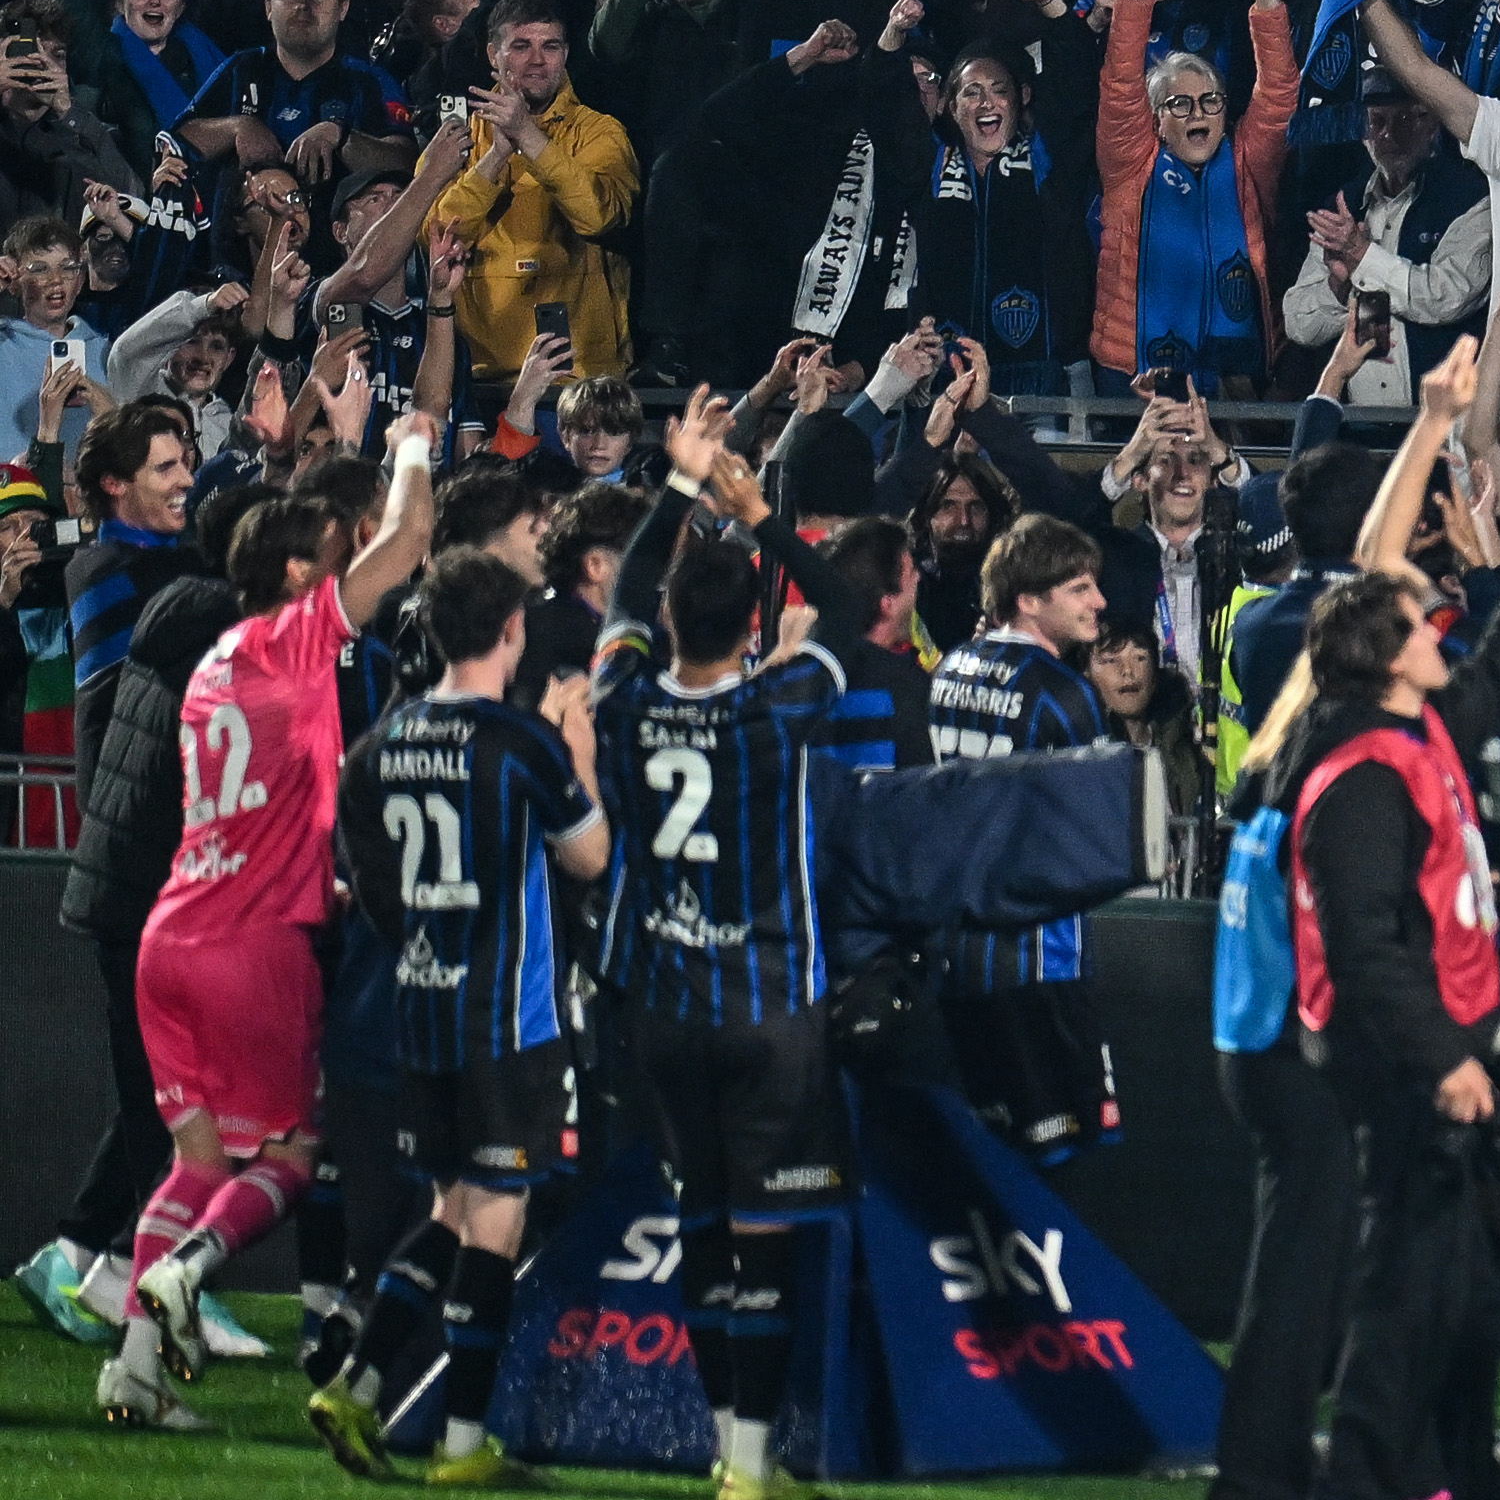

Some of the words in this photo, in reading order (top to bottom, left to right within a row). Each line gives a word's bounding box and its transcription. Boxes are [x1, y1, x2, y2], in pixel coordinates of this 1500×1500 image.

[807, 207, 861, 322] ALWAYS
[379, 747, 471, 782] RANDALL
[644, 748, 721, 863] 2
[382, 790, 481, 911] 21
[952, 1317, 1131, 1382] SPORT
